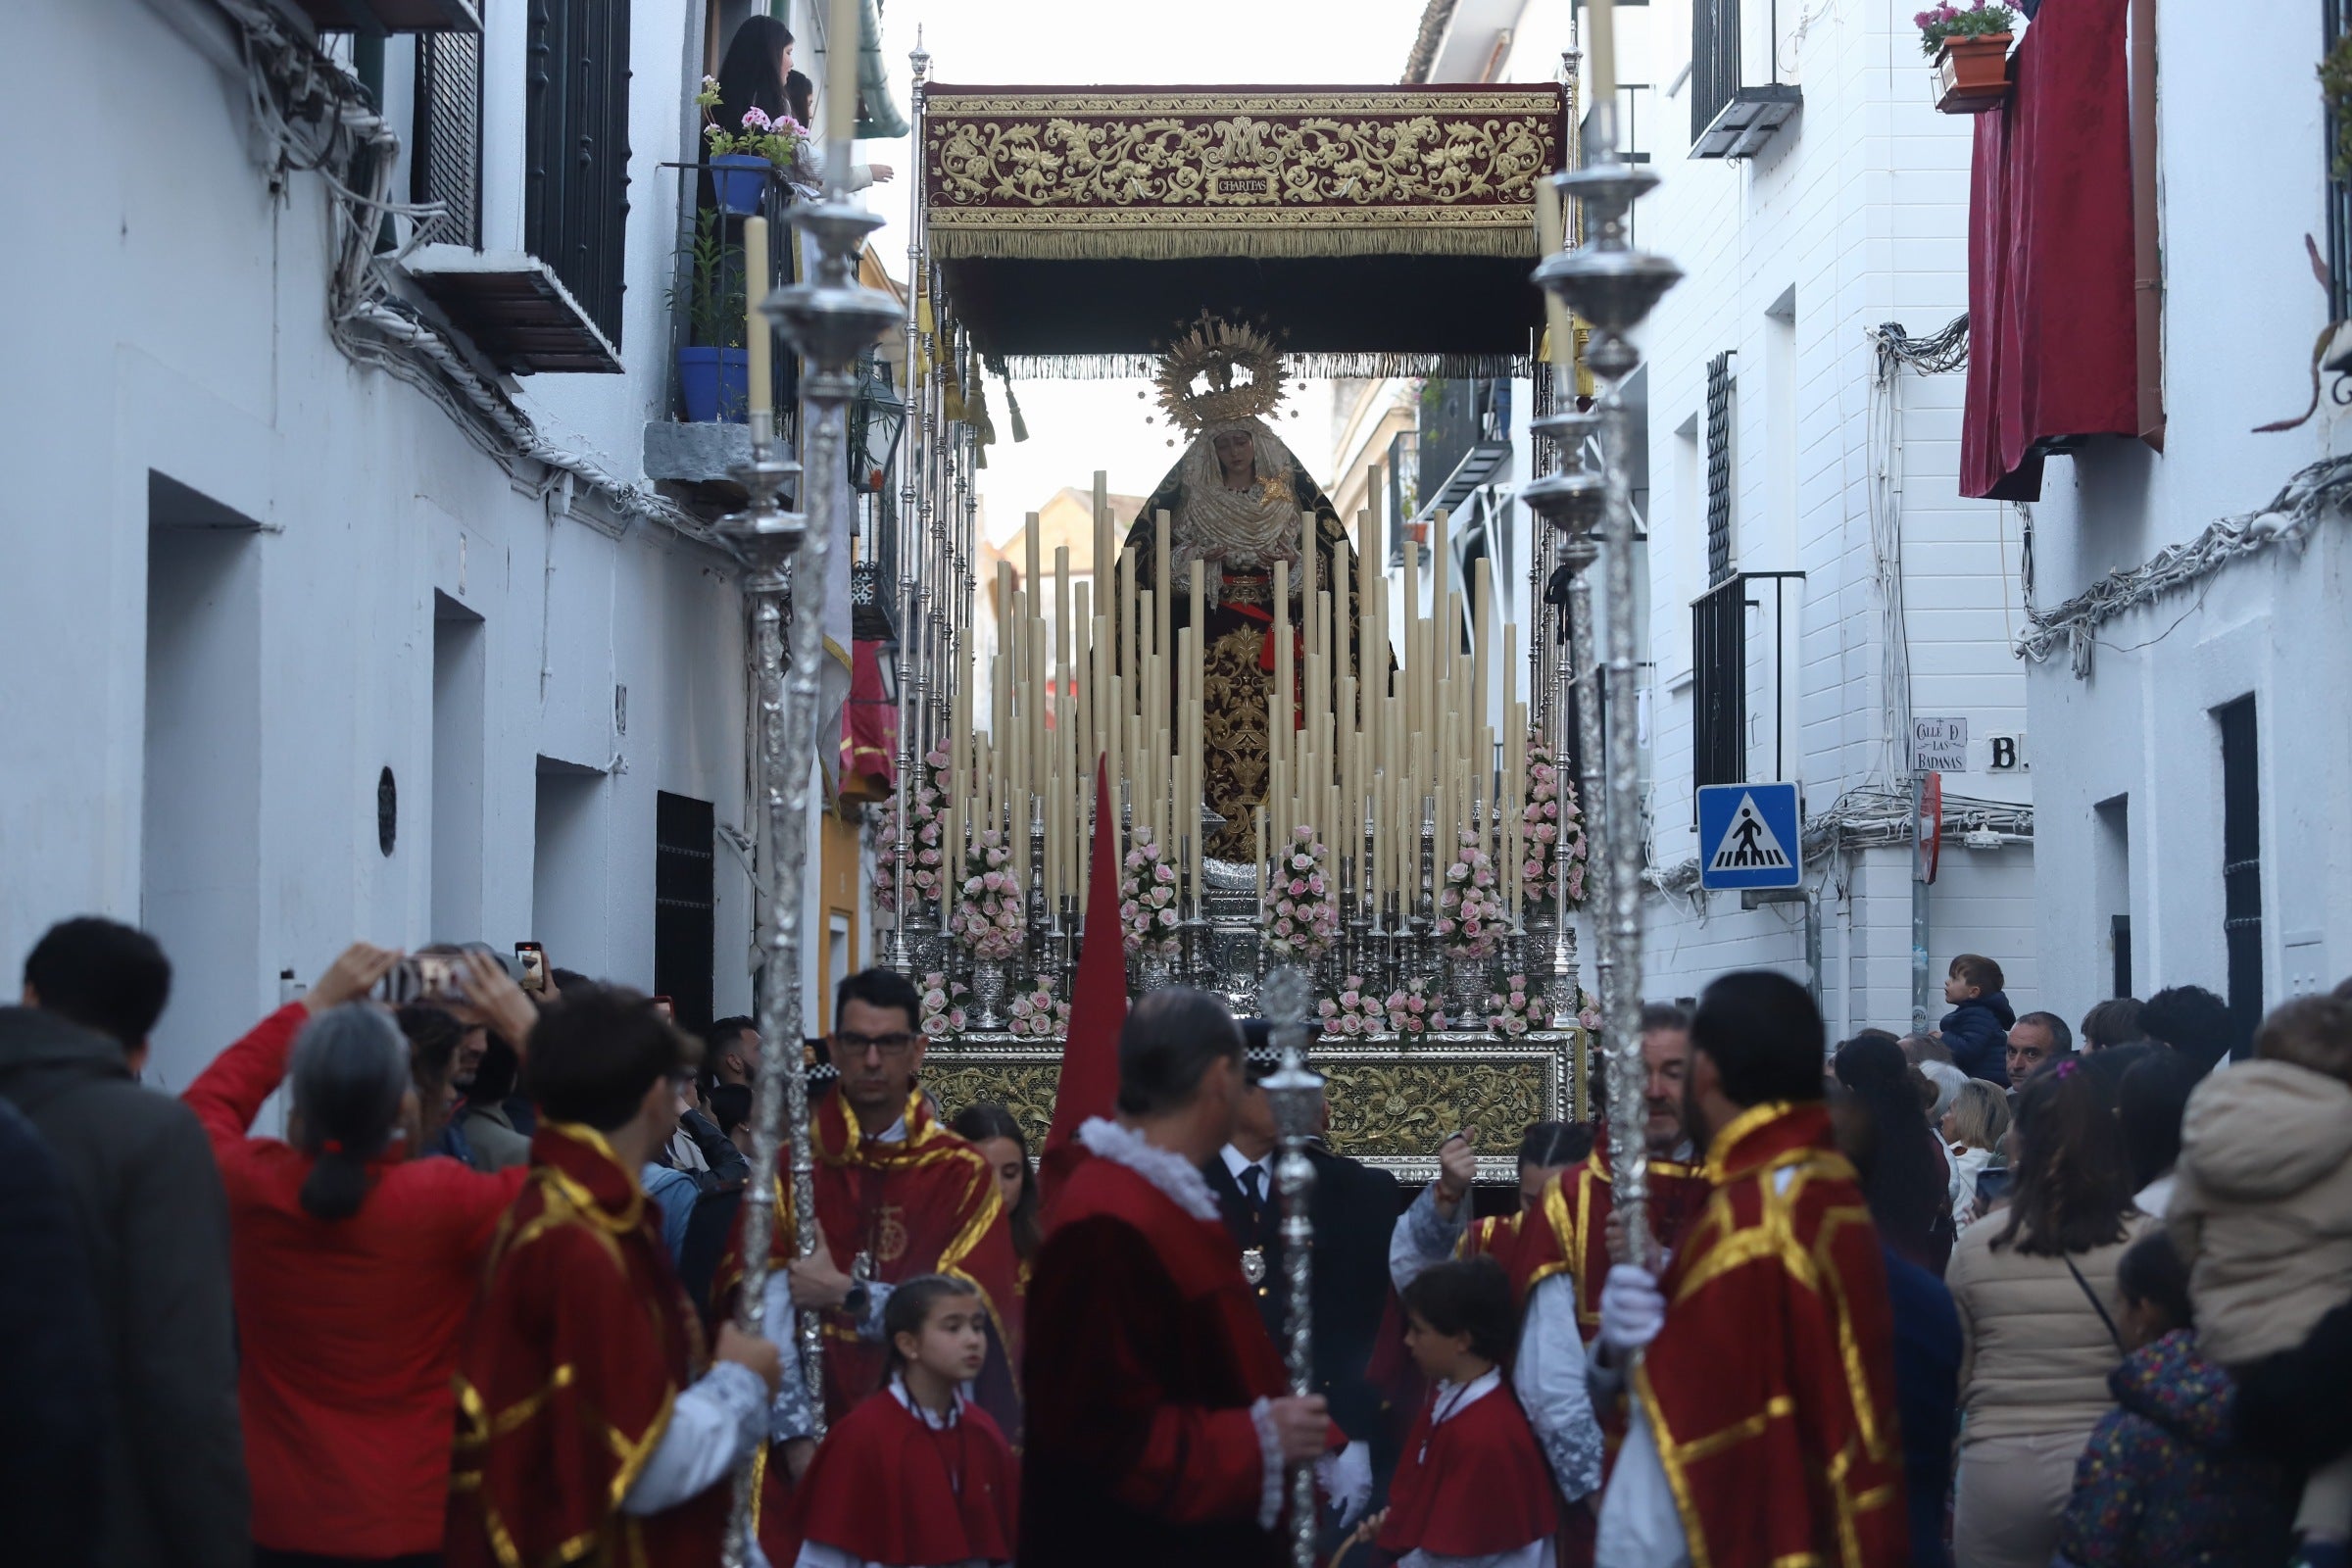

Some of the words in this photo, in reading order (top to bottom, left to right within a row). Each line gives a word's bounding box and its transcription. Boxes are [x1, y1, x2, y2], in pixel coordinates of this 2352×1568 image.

[1218, 180, 1266, 191] CHARITAS
[1917, 723, 1942, 740] CALLE
[1933, 741, 1949, 751] LAS
[1918, 753, 1963, 769] BADANAS
